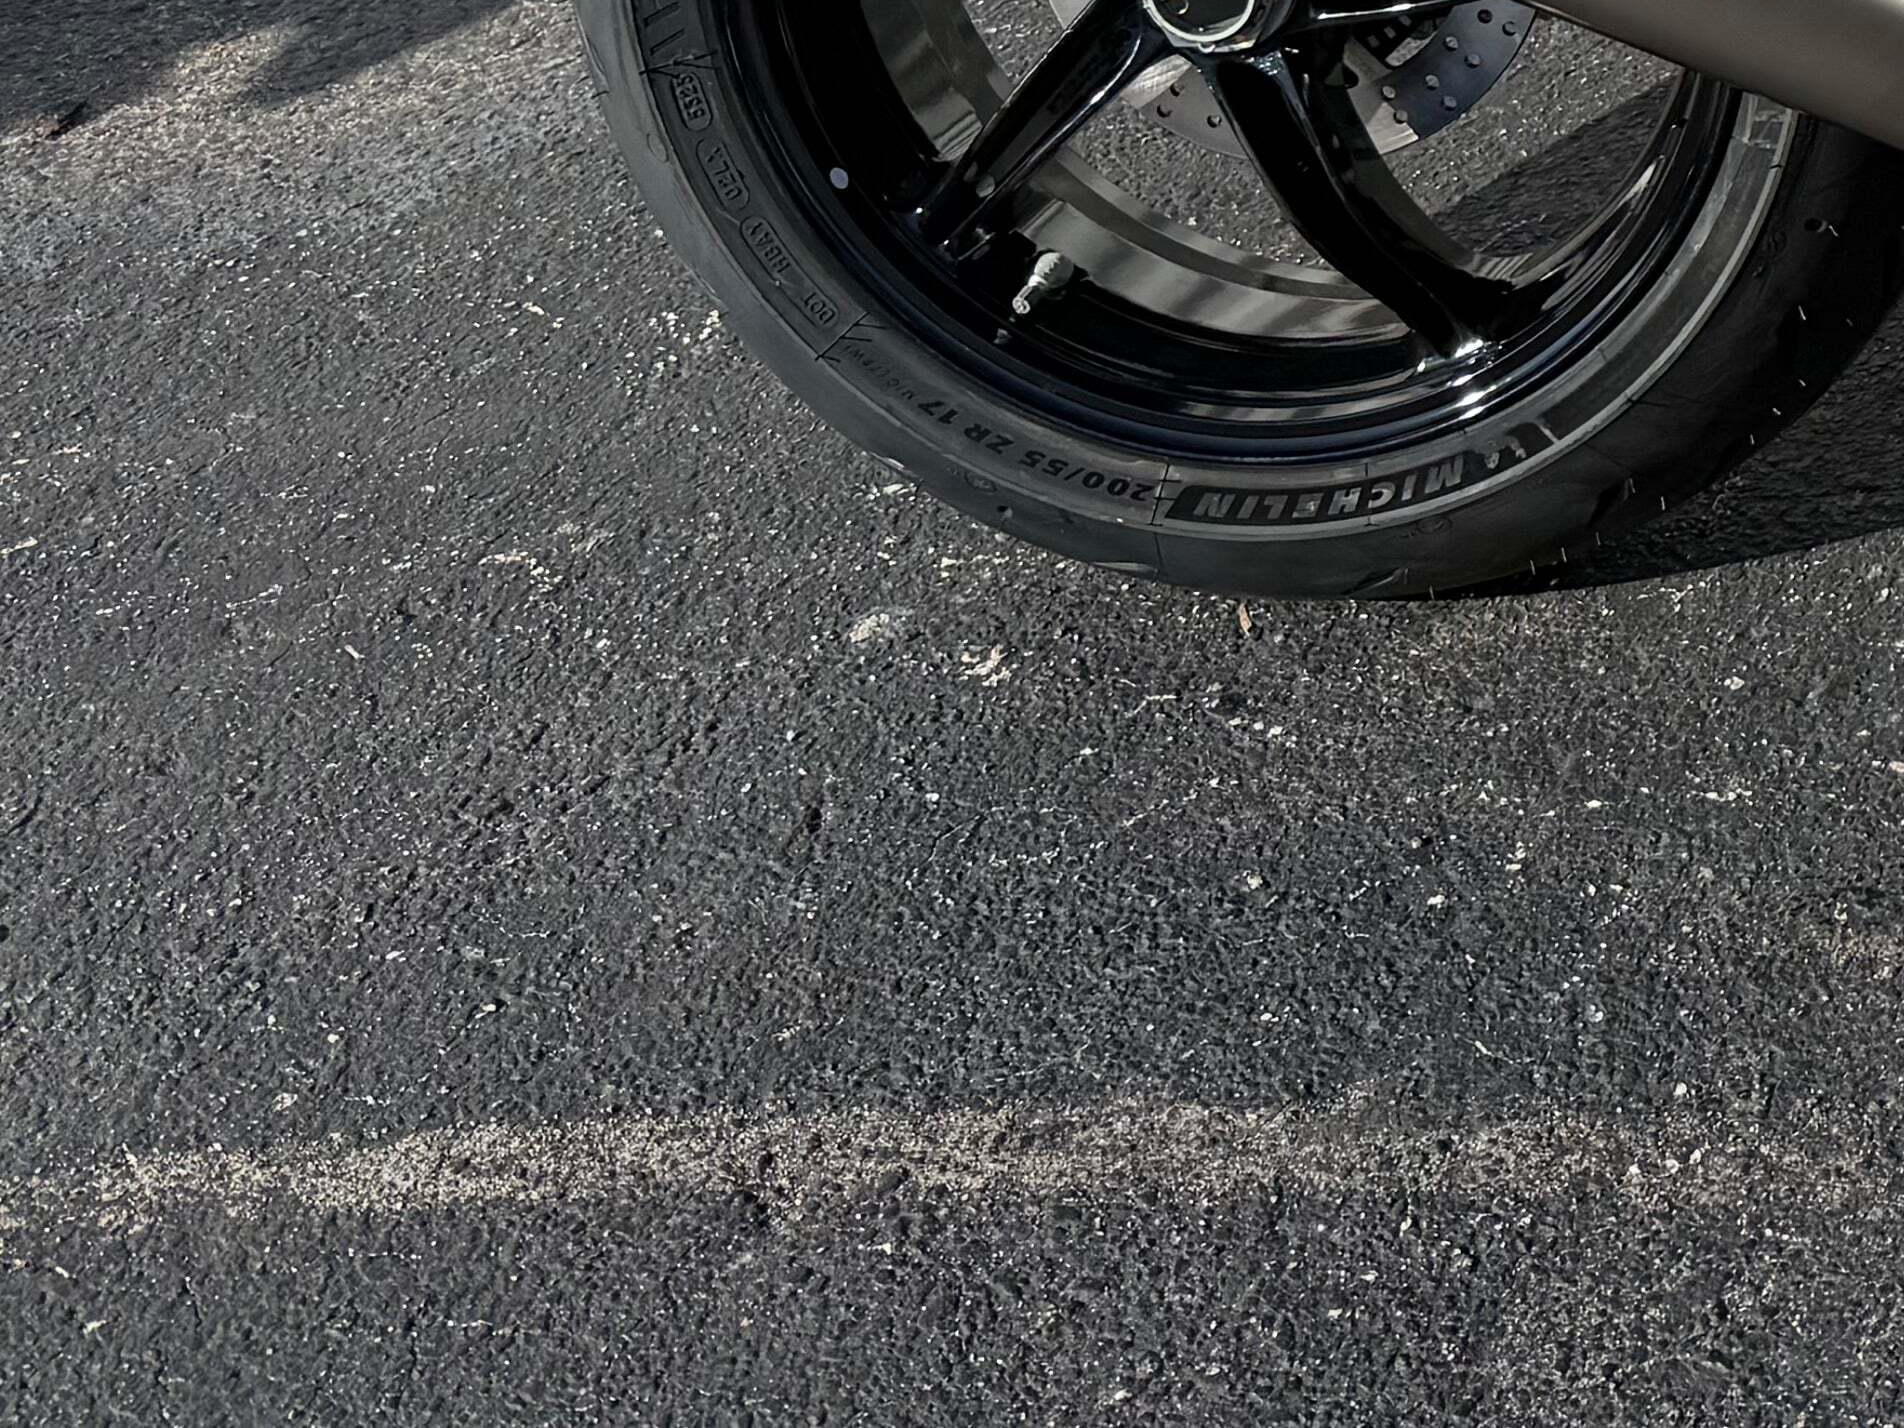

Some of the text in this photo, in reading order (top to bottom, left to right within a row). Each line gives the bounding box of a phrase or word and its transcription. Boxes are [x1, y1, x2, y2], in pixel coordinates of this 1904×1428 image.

[917, 398, 958, 426] 17
[963, 422, 1015, 455] ZR
[1018, 448, 1155, 502] 200/55
[1192, 454, 1465, 520] MICHELIN
